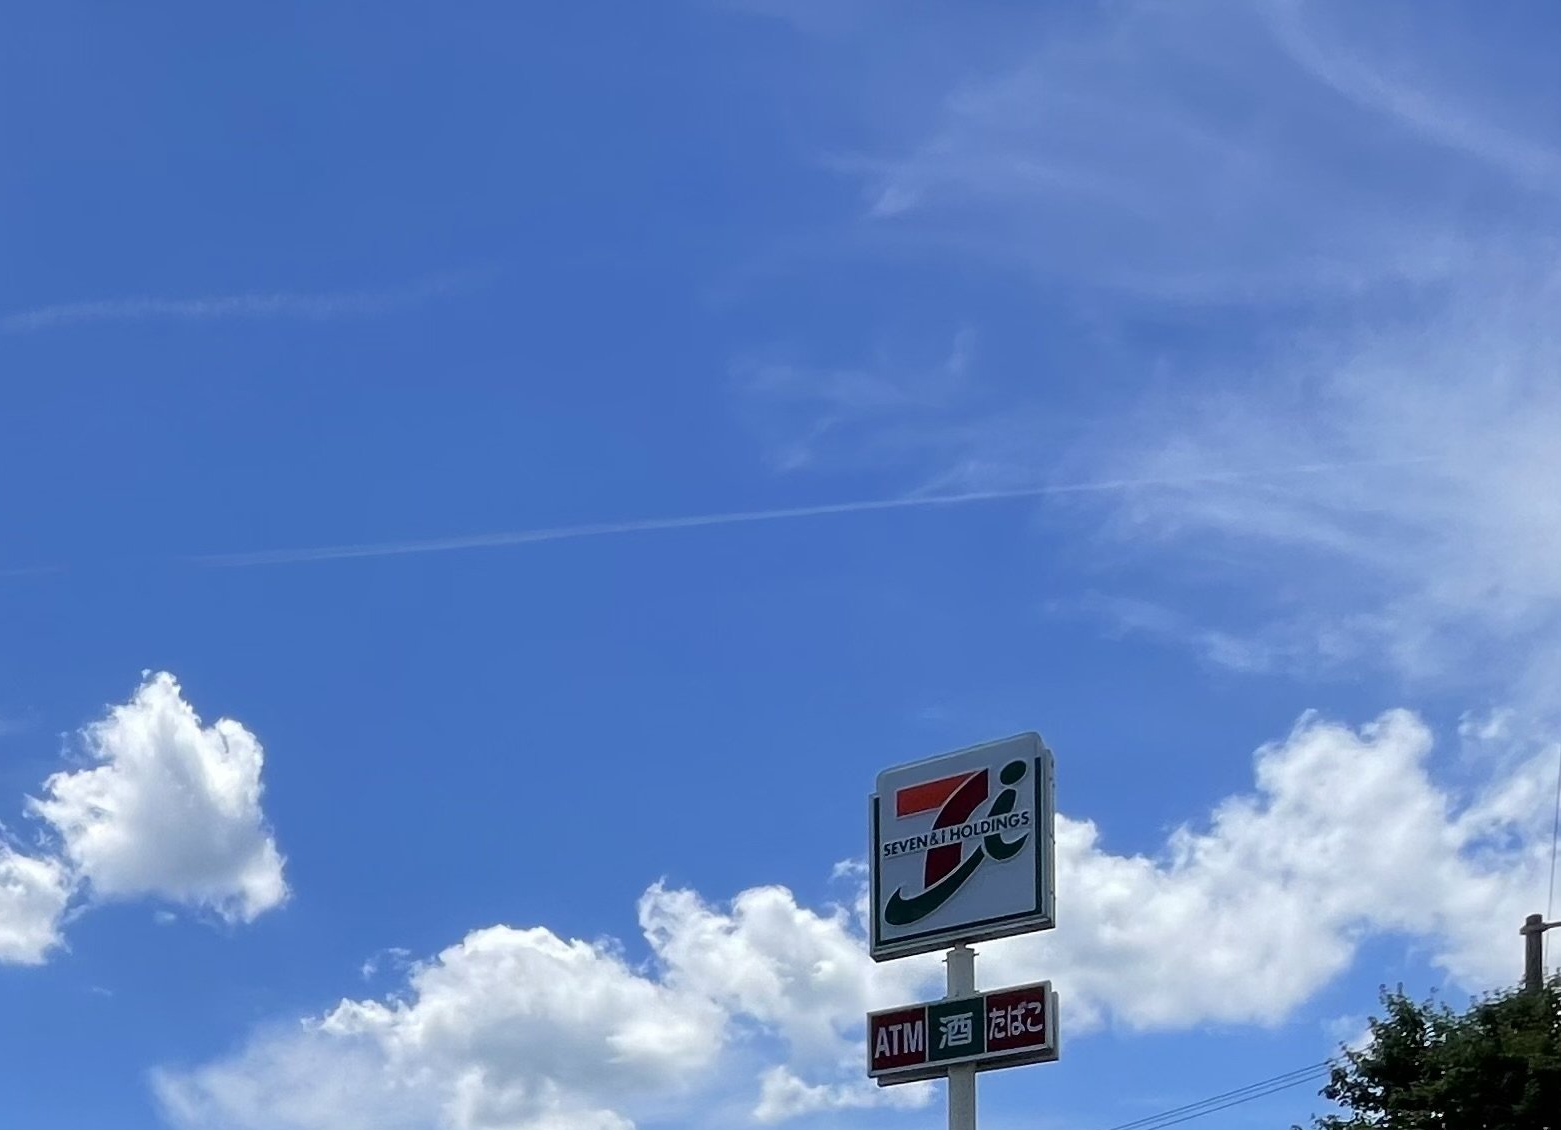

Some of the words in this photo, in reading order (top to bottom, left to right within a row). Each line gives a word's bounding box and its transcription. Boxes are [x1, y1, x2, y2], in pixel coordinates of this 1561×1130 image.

[950, 811, 1030, 841] HOLDINGS
[874, 1019, 924, 1058] ATM
[939, 1012, 973, 1049] 酒
[989, 1001, 1043, 1040] たばこ
